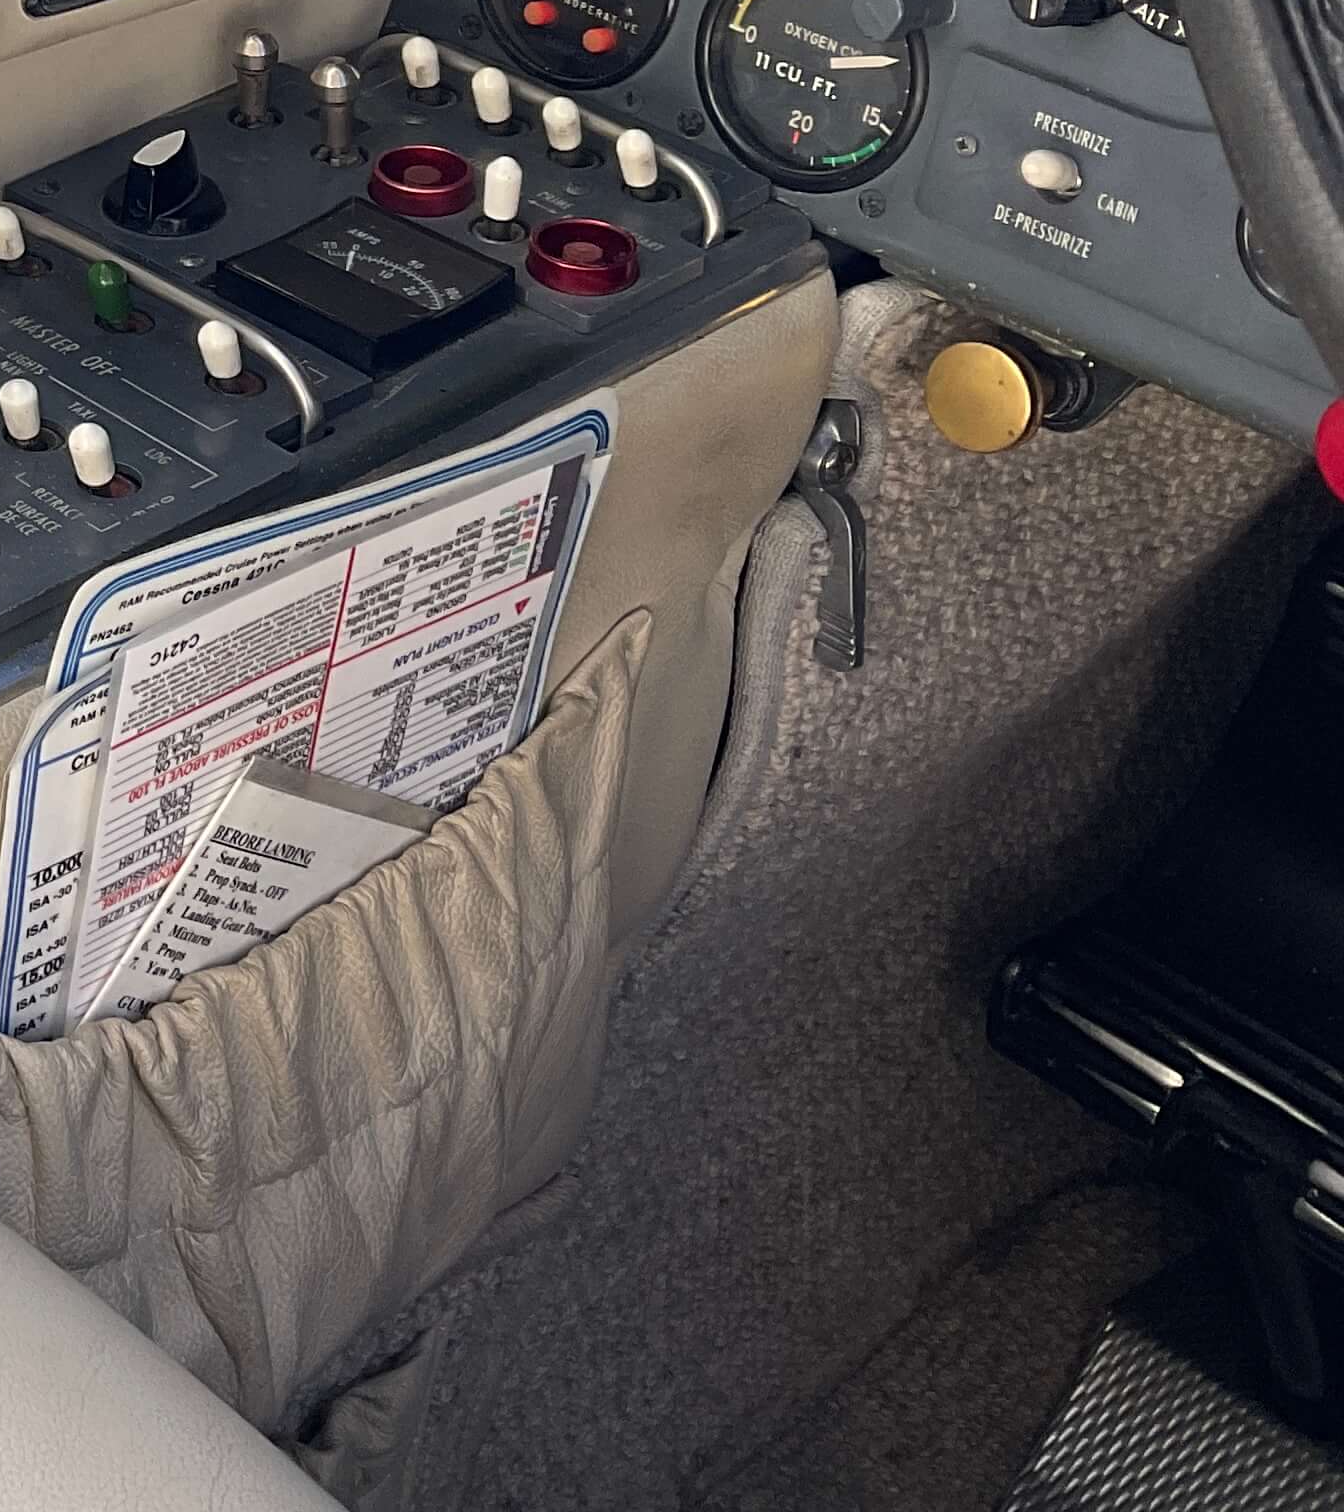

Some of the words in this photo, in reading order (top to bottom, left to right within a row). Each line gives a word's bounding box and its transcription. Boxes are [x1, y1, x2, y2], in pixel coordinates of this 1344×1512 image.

[1133, 3, 1169, 30] ALT
[755, 52, 771, 68] 11
[775, 59, 805, 85] CU.
[811, 75, 837, 99] FT.
[789, 110, 813, 134] 20
[1034, 111, 1112, 156] PRESSURIZE
[1097, 193, 1138, 224] CABIN
[994, 205, 1092, 259] DE-PRESSURIZE
[10, 316, 80, 355] MASTER
[81, 356, 122, 376] OFF
[181, 577, 240, 605] Cessna
[465, 612, 500, 637] CLOSE
[149, 634, 200, 667] C421C
[425, 628, 463, 654] FLIGHT
[392, 647, 422, 670] PLAN
[214, 825, 263, 851] BERORE
[264, 839, 315, 864] LANDING
[217, 851, 238, 867] Seat
[239, 857, 262, 873] Belts
